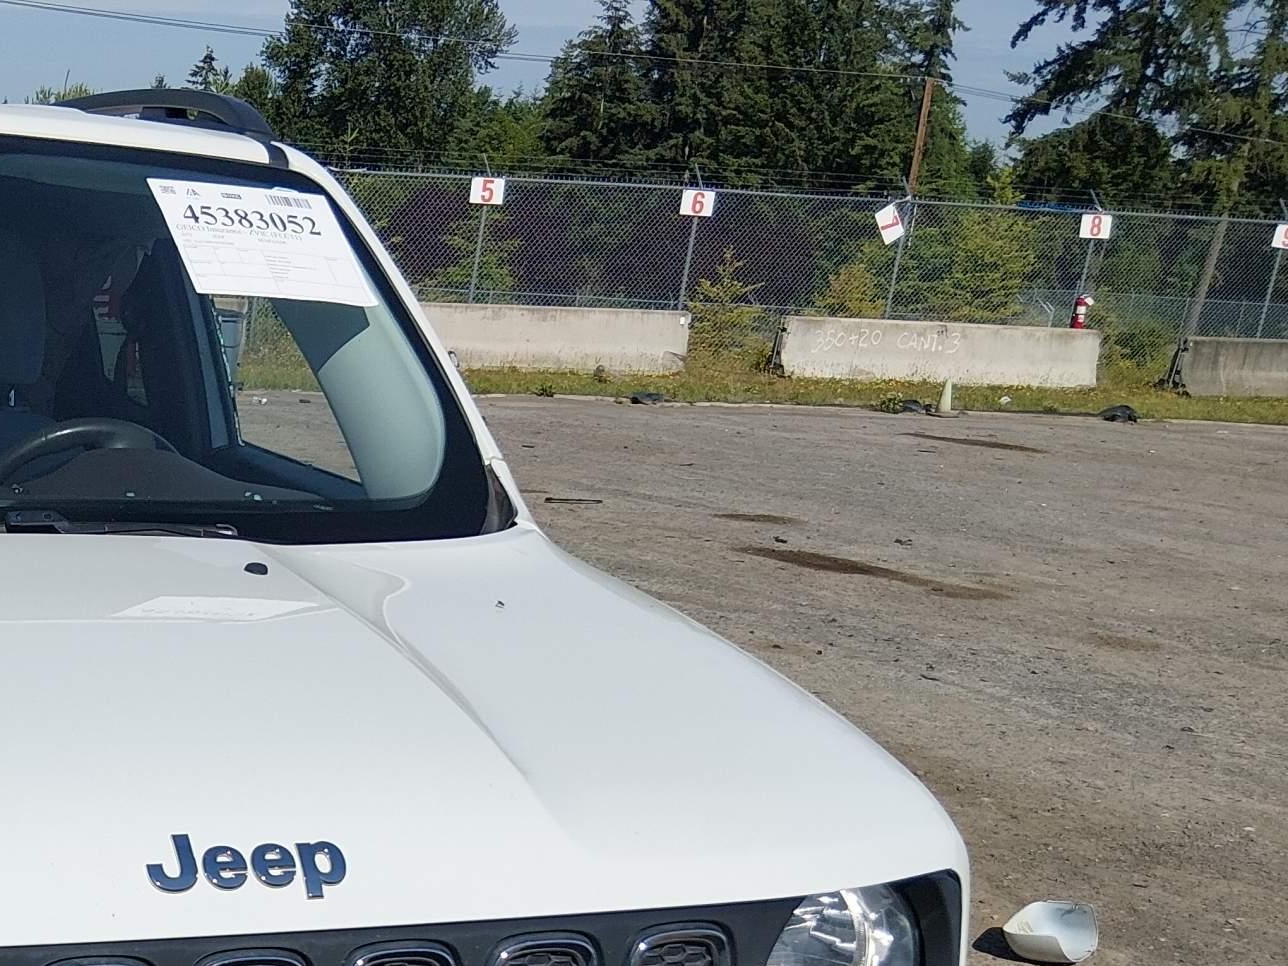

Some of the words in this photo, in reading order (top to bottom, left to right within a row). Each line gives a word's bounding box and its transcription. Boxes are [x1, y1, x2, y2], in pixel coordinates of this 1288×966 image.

[480, 179, 495, 203] 5
[691, 191, 705, 215] 6
[183, 203, 322, 237] 45383052
[1089, 215, 1102, 237] 8
[146, 834, 347, 899] Jeep
